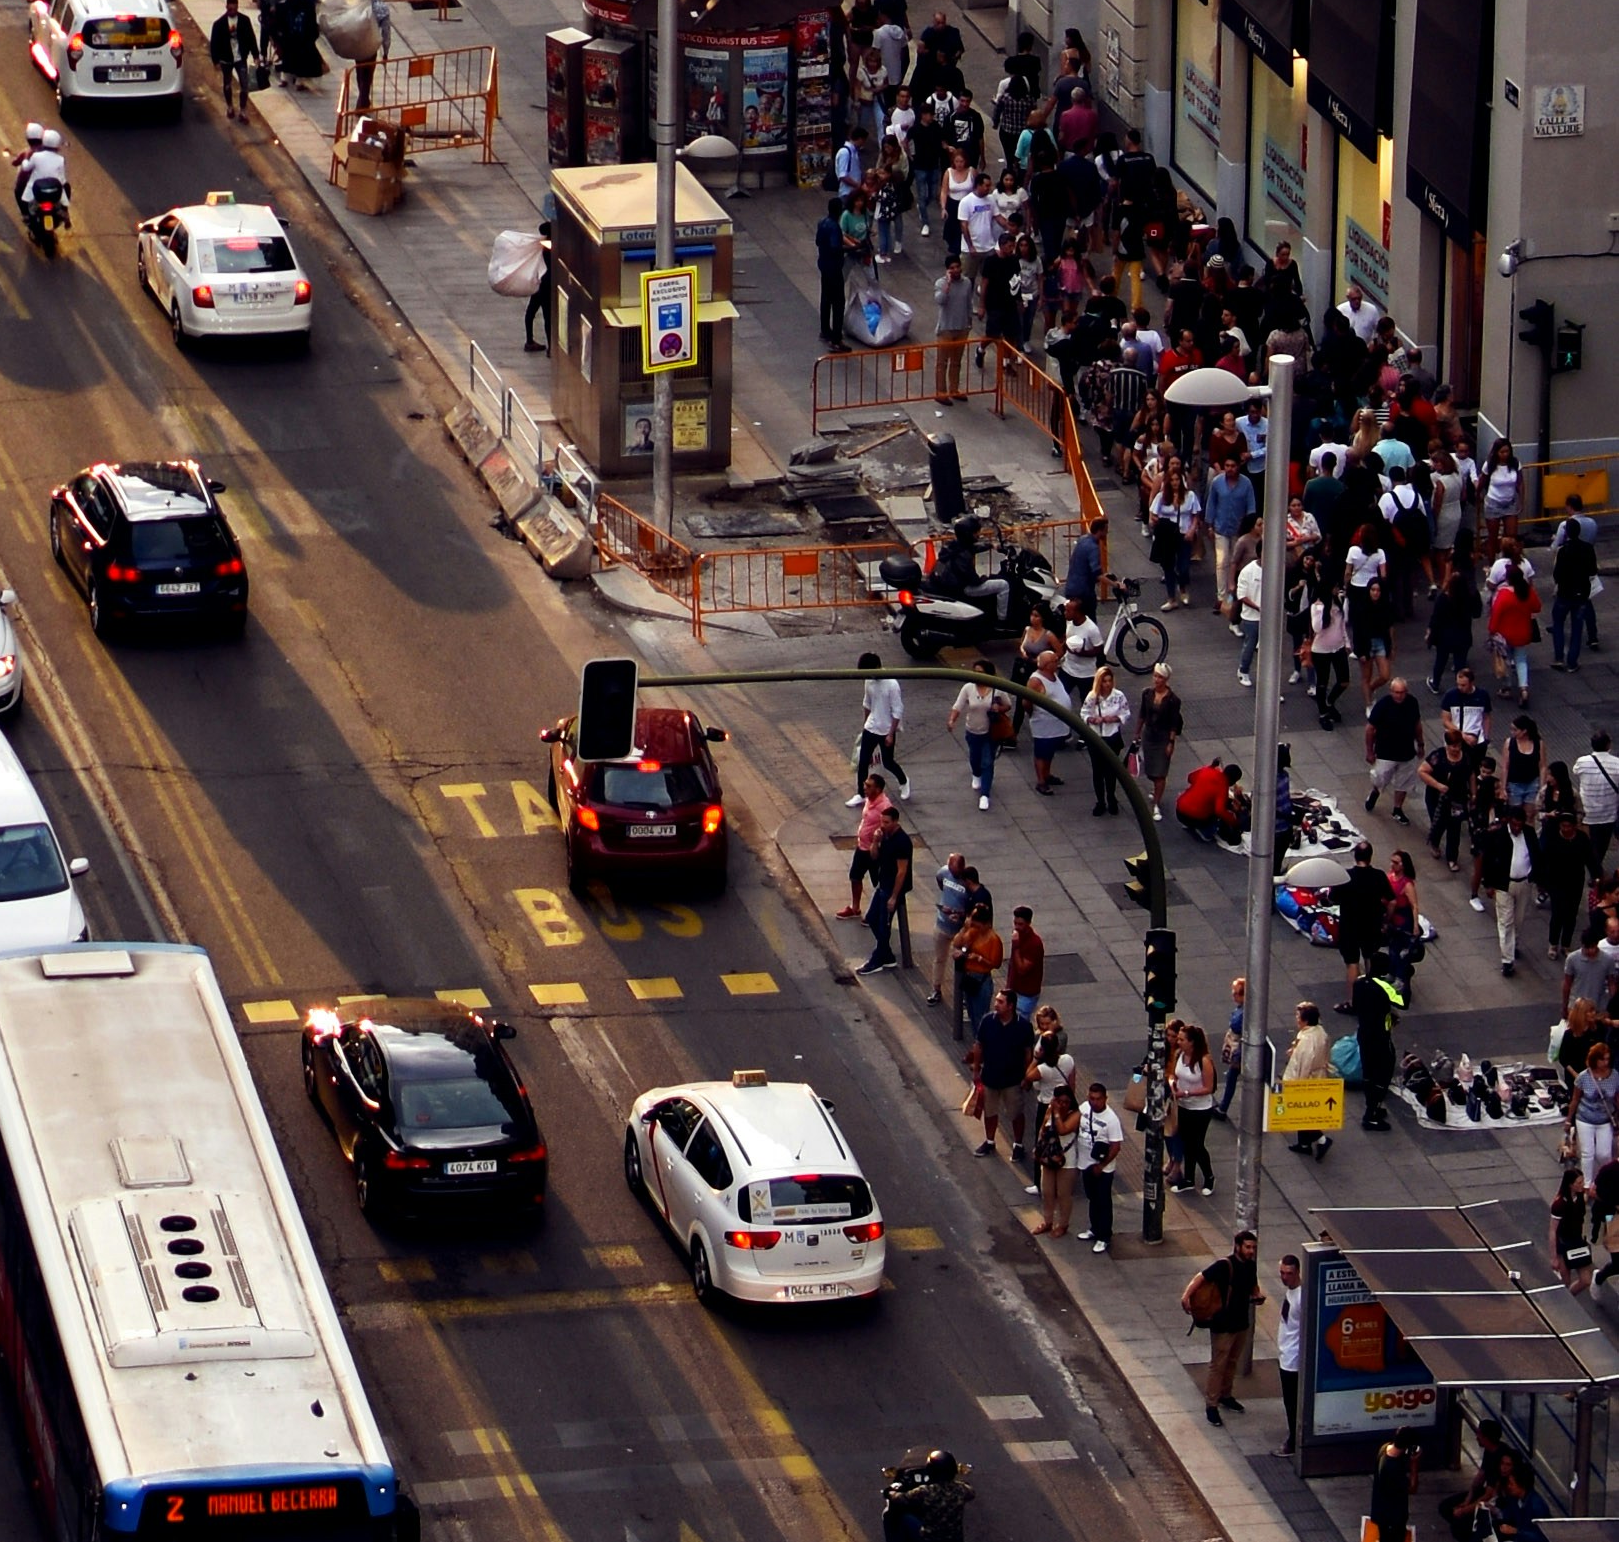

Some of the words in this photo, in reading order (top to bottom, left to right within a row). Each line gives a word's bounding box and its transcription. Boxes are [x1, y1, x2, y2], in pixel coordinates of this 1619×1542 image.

[706, 35, 739, 46] TOURIST
[741, 36, 758, 46] BUS
[1538, 116, 1567, 126] CALLE
[1535, 123, 1584, 136] VALVERDE
[682, 224, 718, 238] Chata
[439, 779, 564, 839] TA
[1287, 1100, 1321, 1110] CALLAO
[449, 1162, 474, 1174] 4074
[790, 1284, 814, 1296] 0444
[1341, 1317, 1354, 1335] 6
[1364, 1388, 1436, 1414] yoigo
[208, 1491, 266, 1517] MANUEL
[270, 1488, 338, 1514] BECERRA
